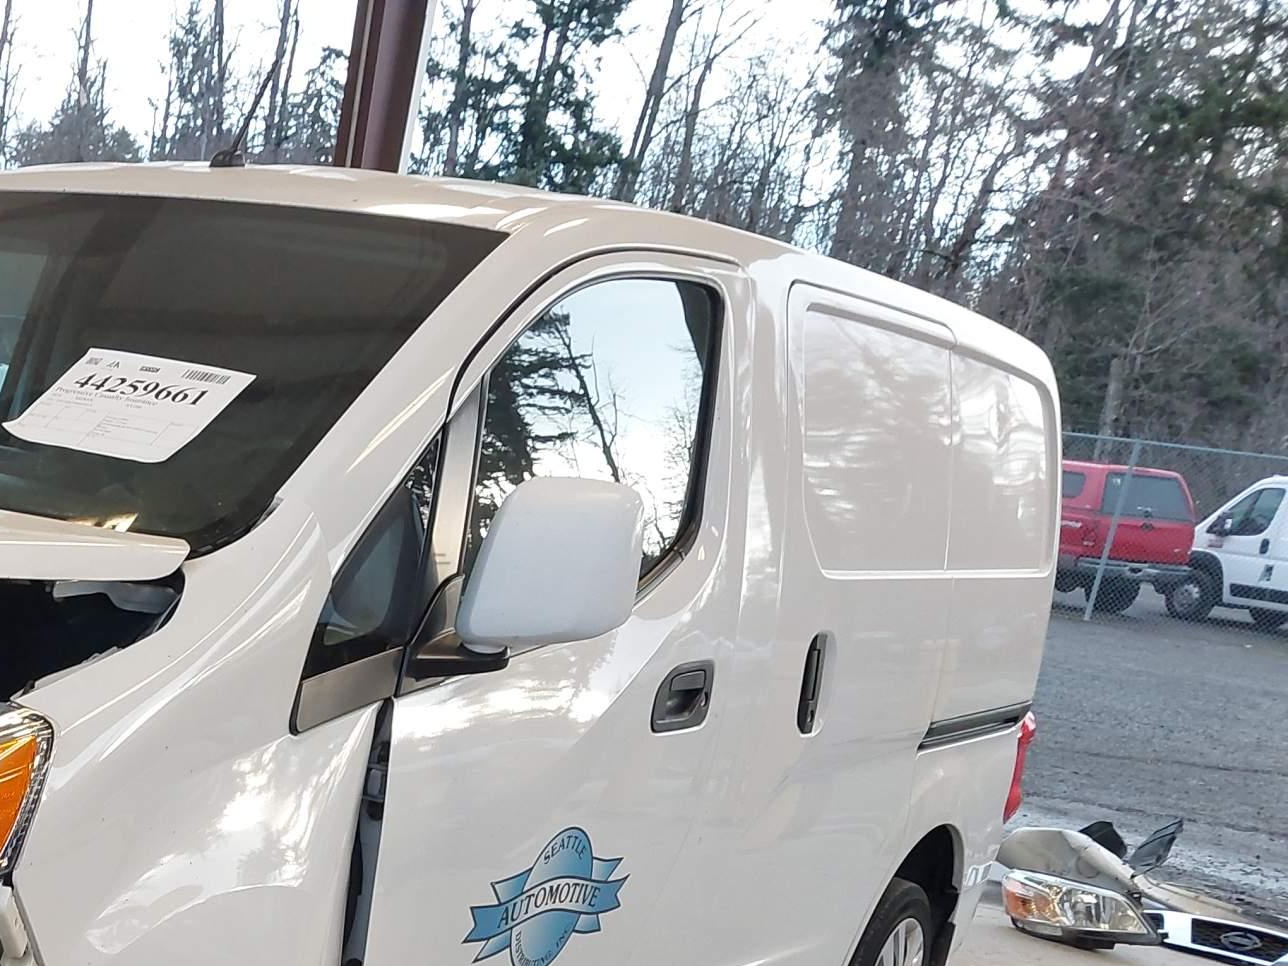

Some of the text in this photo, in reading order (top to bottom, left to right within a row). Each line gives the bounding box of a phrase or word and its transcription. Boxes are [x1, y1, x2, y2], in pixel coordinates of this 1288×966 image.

[73, 373, 209, 406] 44259661
[542, 835, 587, 864] SEATTLE
[497, 882, 601, 929] AUTOMOTIVE
